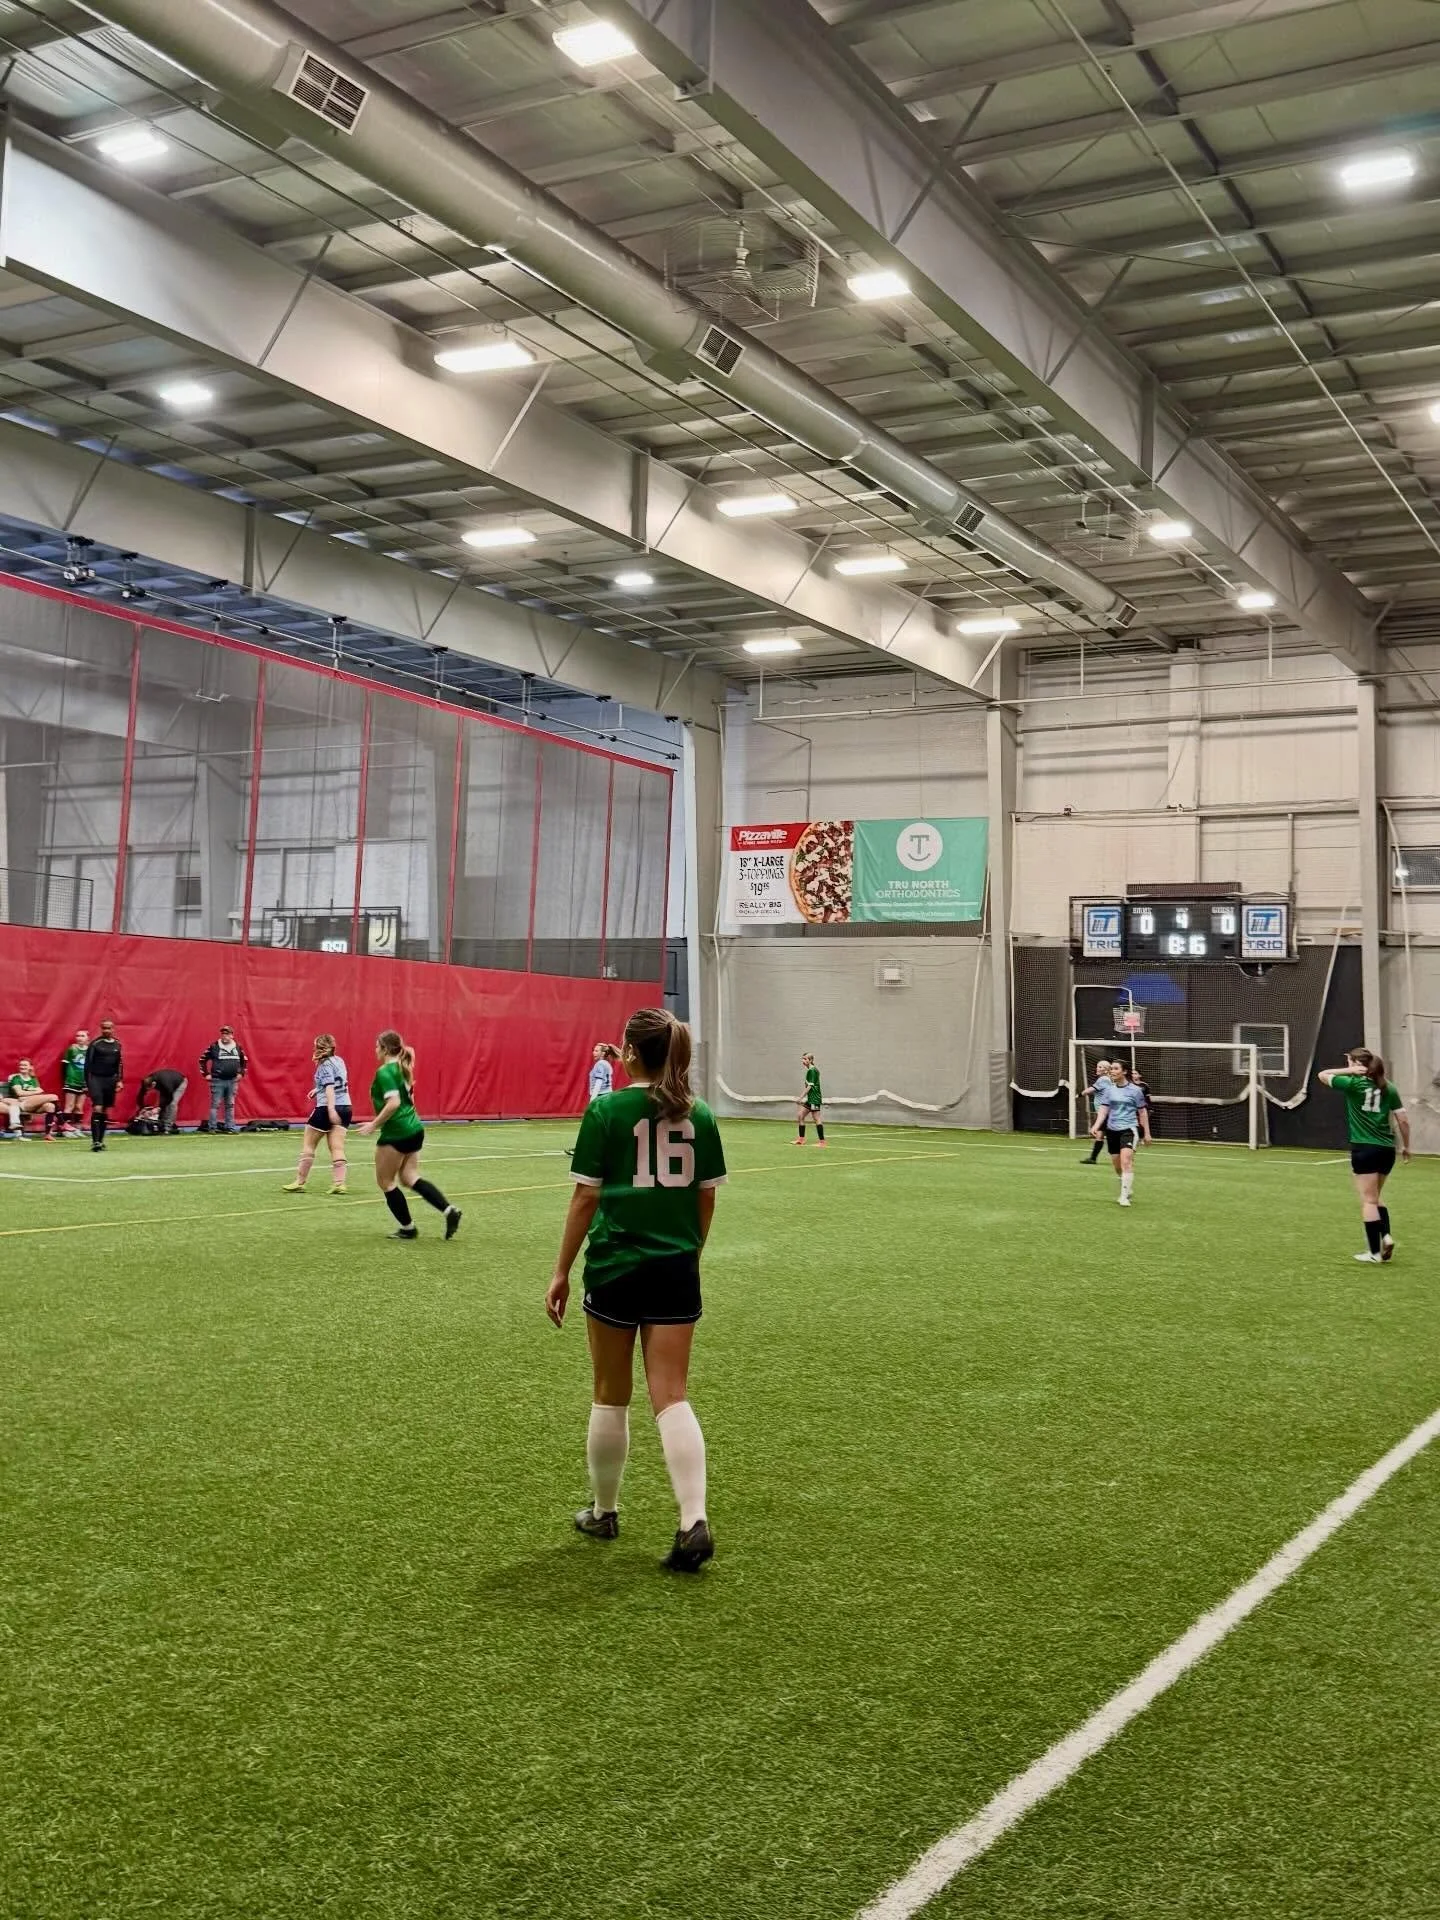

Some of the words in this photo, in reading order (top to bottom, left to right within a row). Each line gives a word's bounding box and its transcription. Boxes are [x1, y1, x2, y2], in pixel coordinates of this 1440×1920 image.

[739, 829, 787, 841] Pizzaville
[753, 856, 785, 867] X-LARGE
[888, 880, 909, 889] TRU
[911, 880, 950, 889] NORTH
[875, 889, 961, 899] ORTHODONTICS
[739, 901, 767, 910] REALLY
[1140, 914, 1154, 934] 0
[1221, 914, 1236, 934] 0
[1087, 940, 1121, 949] TRIO
[1246, 940, 1284, 949] TRIO
[1361, 1087, 1382, 1113] 11
[632, 1118, 696, 1188] 16
